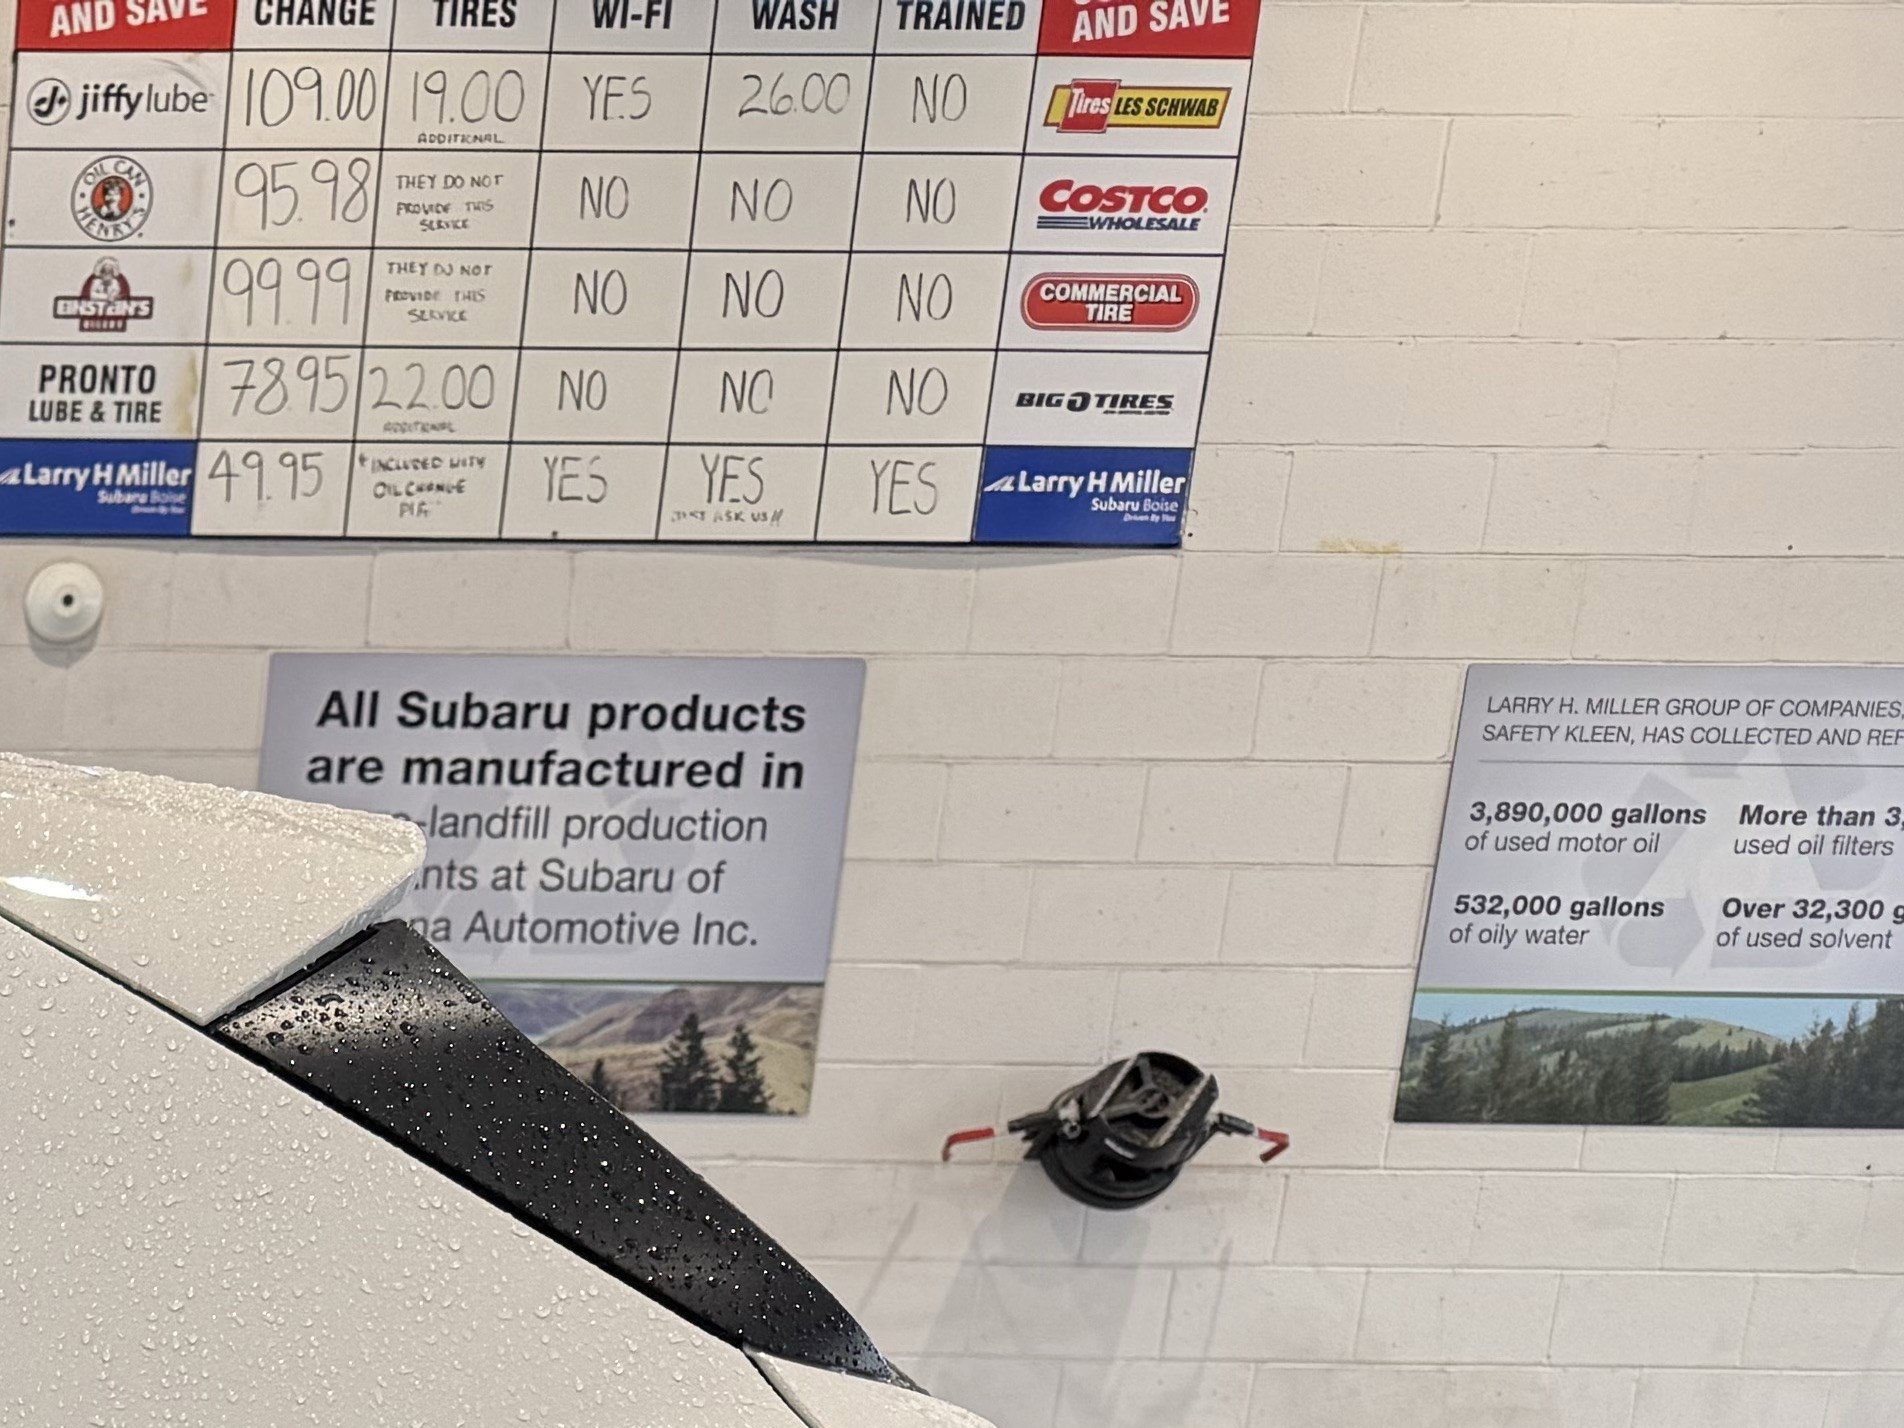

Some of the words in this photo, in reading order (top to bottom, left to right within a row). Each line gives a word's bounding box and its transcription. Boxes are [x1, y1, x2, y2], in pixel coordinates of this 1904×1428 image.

[50, 2, 115, 38] AND
[126, 0, 208, 26] SAVE
[254, 0, 376, 26] CHANGE
[434, 0, 517, 28] TIRES
[593, 0, 672, 30] WI-FI
[751, 0, 839, 30] WASH
[896, 0, 1026, 31] TRAINED
[1072, 6, 1137, 43] AND
[1148, 0, 1230, 33] SAVE
[245, 66, 377, 127] 109.00
[411, 69, 525, 124] 19.00
[582, 75, 652, 121] YES
[737, 72, 851, 117] 26.00
[912, 73, 967, 124] NO
[1067, 87, 1111, 118] Tires
[1114, 98, 1143, 116] LES
[1145, 97, 1220, 118] SCHWAB
[82, 160, 110, 185] OIL
[113, 159, 146, 187] CAN
[396, 174, 437, 190] THEY
[443, 174, 464, 190] DO
[470, 173, 505, 189] NOT
[234, 157, 372, 231] 95.98
[579, 175, 629, 220] NO
[730, 178, 793, 223] NO
[906, 177, 957, 225] NO
[1039, 178, 1209, 215] COSTCO
[1088, 216, 1202, 232] WHOLESALE
[387, 261, 428, 277] THEY
[460, 263, 494, 278] NOT
[574, 269, 628, 316] NO
[722, 269, 784, 318] NO
[897, 272, 953, 322] NO
[1040, 283, 1182, 304] COMMERCIAL
[1085, 303, 1135, 323] TIRE
[39, 364, 156, 394] PRONTO
[368, 362, 495, 411] 22.00
[558, 369, 607, 412] NO
[887, 367, 949, 416] NO
[28, 401, 81, 423] LUBE
[90, 401, 106, 423] &
[115, 401, 163, 423] TIRE
[1016, 392, 1066, 408] BIG
[1094, 393, 1175, 410] TIRES
[24, 462, 90, 492] Larry
[94, 462, 113, 485] H
[116, 461, 191, 487] Miller
[207, 450, 323, 503] 49.95
[543, 455, 608, 503] YES
[700, 453, 765, 504] YES
[870, 459, 939, 515] YES
[1018, 471, 1085, 498] Larry
[1087, 471, 1107, 493] H
[1111, 470, 1187, 494] Miller
[1091, 497, 1140, 512] Subaru
[1143, 498, 1179, 513] Boise
[316, 690, 380, 728] All
[397, 690, 570, 730] Subaru
[588, 694, 807, 738] products
[1486, 697, 1554, 715] LARRY
[1558, 697, 1579, 715] H.
[1585, 698, 1660, 716] MILLER
[1665, 698, 1740, 717] GROUP
[1745, 699, 1774, 718] OF
[1482, 724, 1559, 742] SAFETY
[1564, 724, 1635, 746] KLEEN,
[1642, 726, 1685, 745] HAS
[1691, 726, 1812, 746] COLLECTED
[1817, 728, 1861, 746] AND
[306, 755, 384, 785] are
[402, 750, 745, 789] manufactured
[761, 753, 805, 790] in
[562, 808, 768, 847] production
[1469, 801, 1603, 827] 3,890,000
[1610, 802, 1707, 828] gallons
[1739, 804, 1808, 826] More
[1816, 805, 1876, 827] than
[1464, 831, 1490, 852] of
[1495, 832, 1550, 853] used
[1557, 834, 1627, 854] motor
[1633, 832, 1660, 854] oil
[1733, 834, 1791, 856] used
[1797, 834, 1824, 856] oil
[1831, 834, 1894, 857] filters
[414, 860, 478, 892] nts
[492, 859, 526, 891] at
[538, 857, 675, 894] Subaru
[686, 859, 729, 895] of
[1454, 895, 1562, 920] 532,000
[1569, 895, 1665, 921] gallons
[1721, 898, 1786, 920] Over
[1792, 899, 1885, 924] 32,300
[463, 910, 679, 946] Automotive
[692, 911, 759, 947] Inc.
[1448, 925, 1474, 945] of
[1478, 925, 1519, 950] oily
[1525, 927, 1590, 946] water
[1716, 927, 1742, 947] of
[1746, 928, 1803, 949] used
[1809, 928, 1894, 950] solvent
